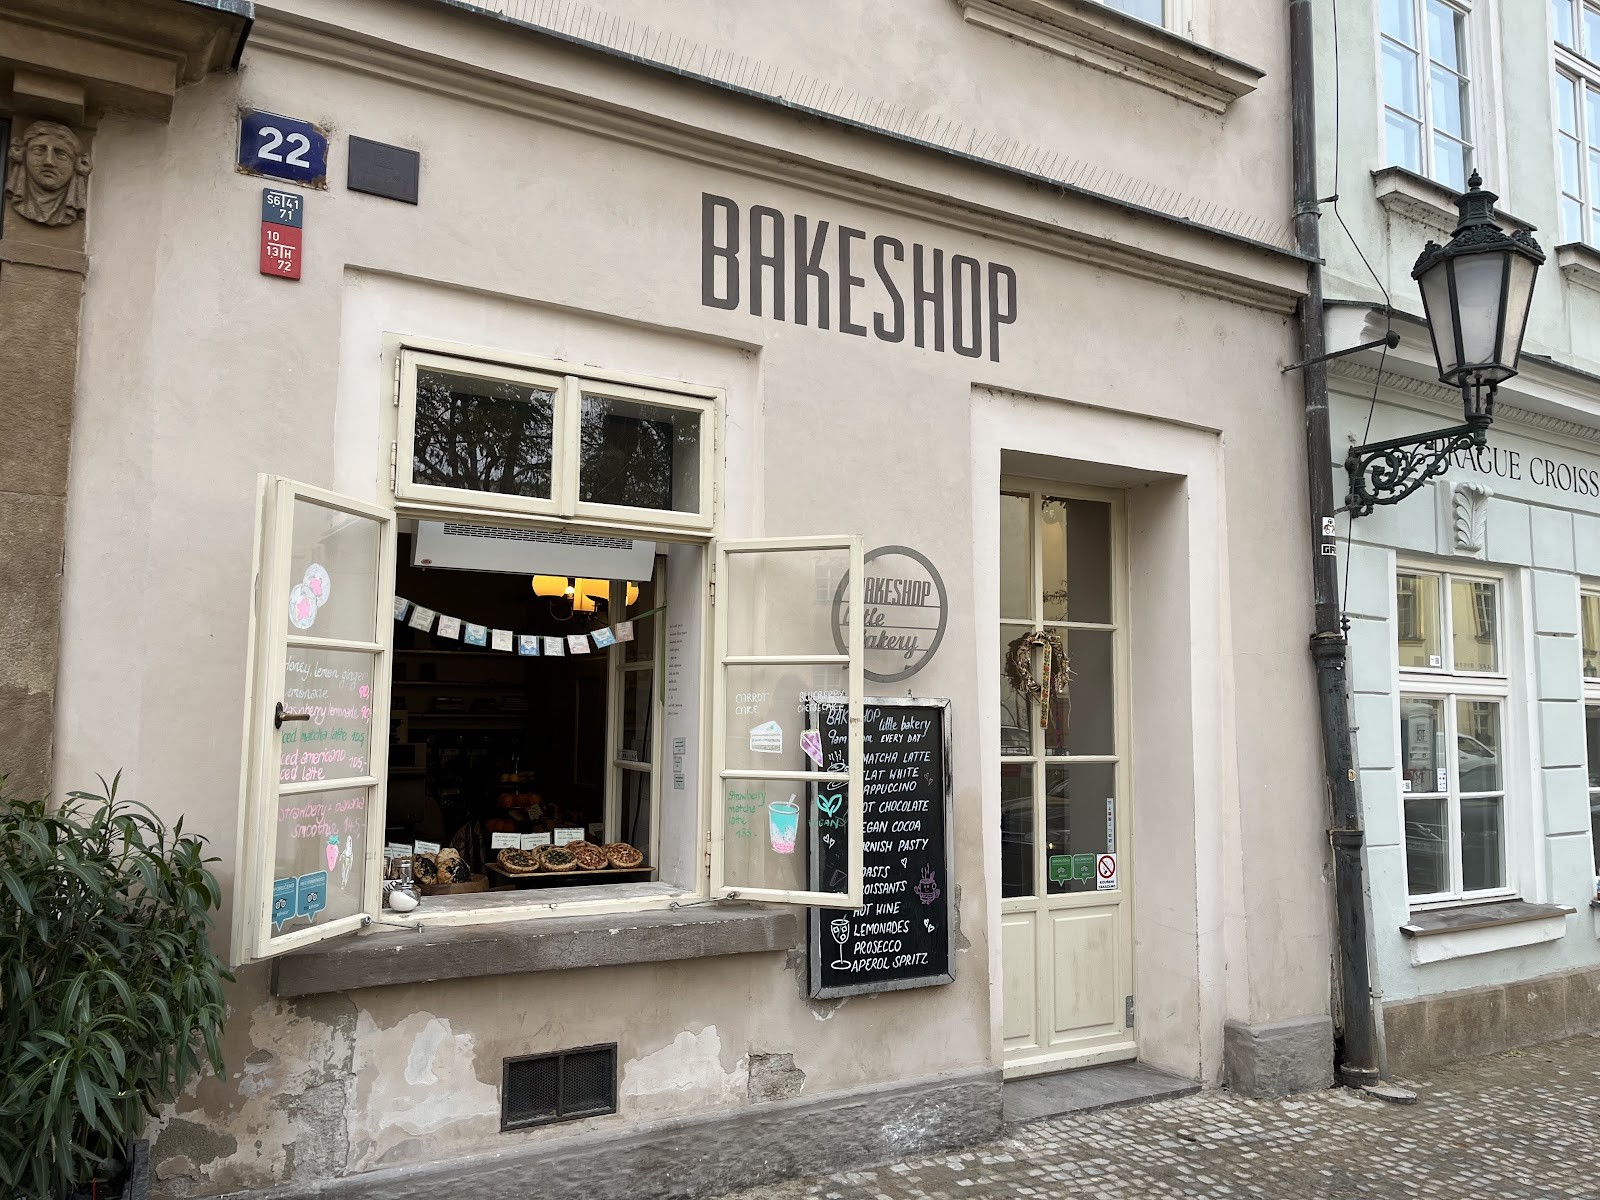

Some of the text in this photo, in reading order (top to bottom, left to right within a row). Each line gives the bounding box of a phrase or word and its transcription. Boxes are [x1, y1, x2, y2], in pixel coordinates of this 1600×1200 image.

[257, 126, 311, 169] 22
[266, 230, 280, 241] 10
[701, 191, 1017, 363] BAKESHOP
[1530, 457, 1600, 497] CROISS
[864, 577, 931, 606] AKESHOP
[864, 630, 918, 659] akery
[735, 692, 769, 703] CARROT
[735, 705, 758, 715] CAKE
[826, 708, 880, 726] BAKHOP
[901, 715, 931, 738] bakery
[881, 734, 904, 743] EVERY
[301, 748, 346, 764] americano
[903, 751, 931, 763] LATTE
[863, 767, 919, 781] LAT WHITE
[864, 781, 917, 795] APPUCCINO
[863, 800, 929, 813] OT CHOCOLATE
[863, 820, 921, 833] EGAN COCOA
[863, 838, 929, 853] RNISH PASTY
[863, 880, 908, 895] OISSANTS
[876, 902, 901, 915] WINE
[854, 920, 910, 936] LEMONADES
[854, 940, 902, 954] PROSECCO
[851, 953, 929, 972] APEROL SPRITZ
